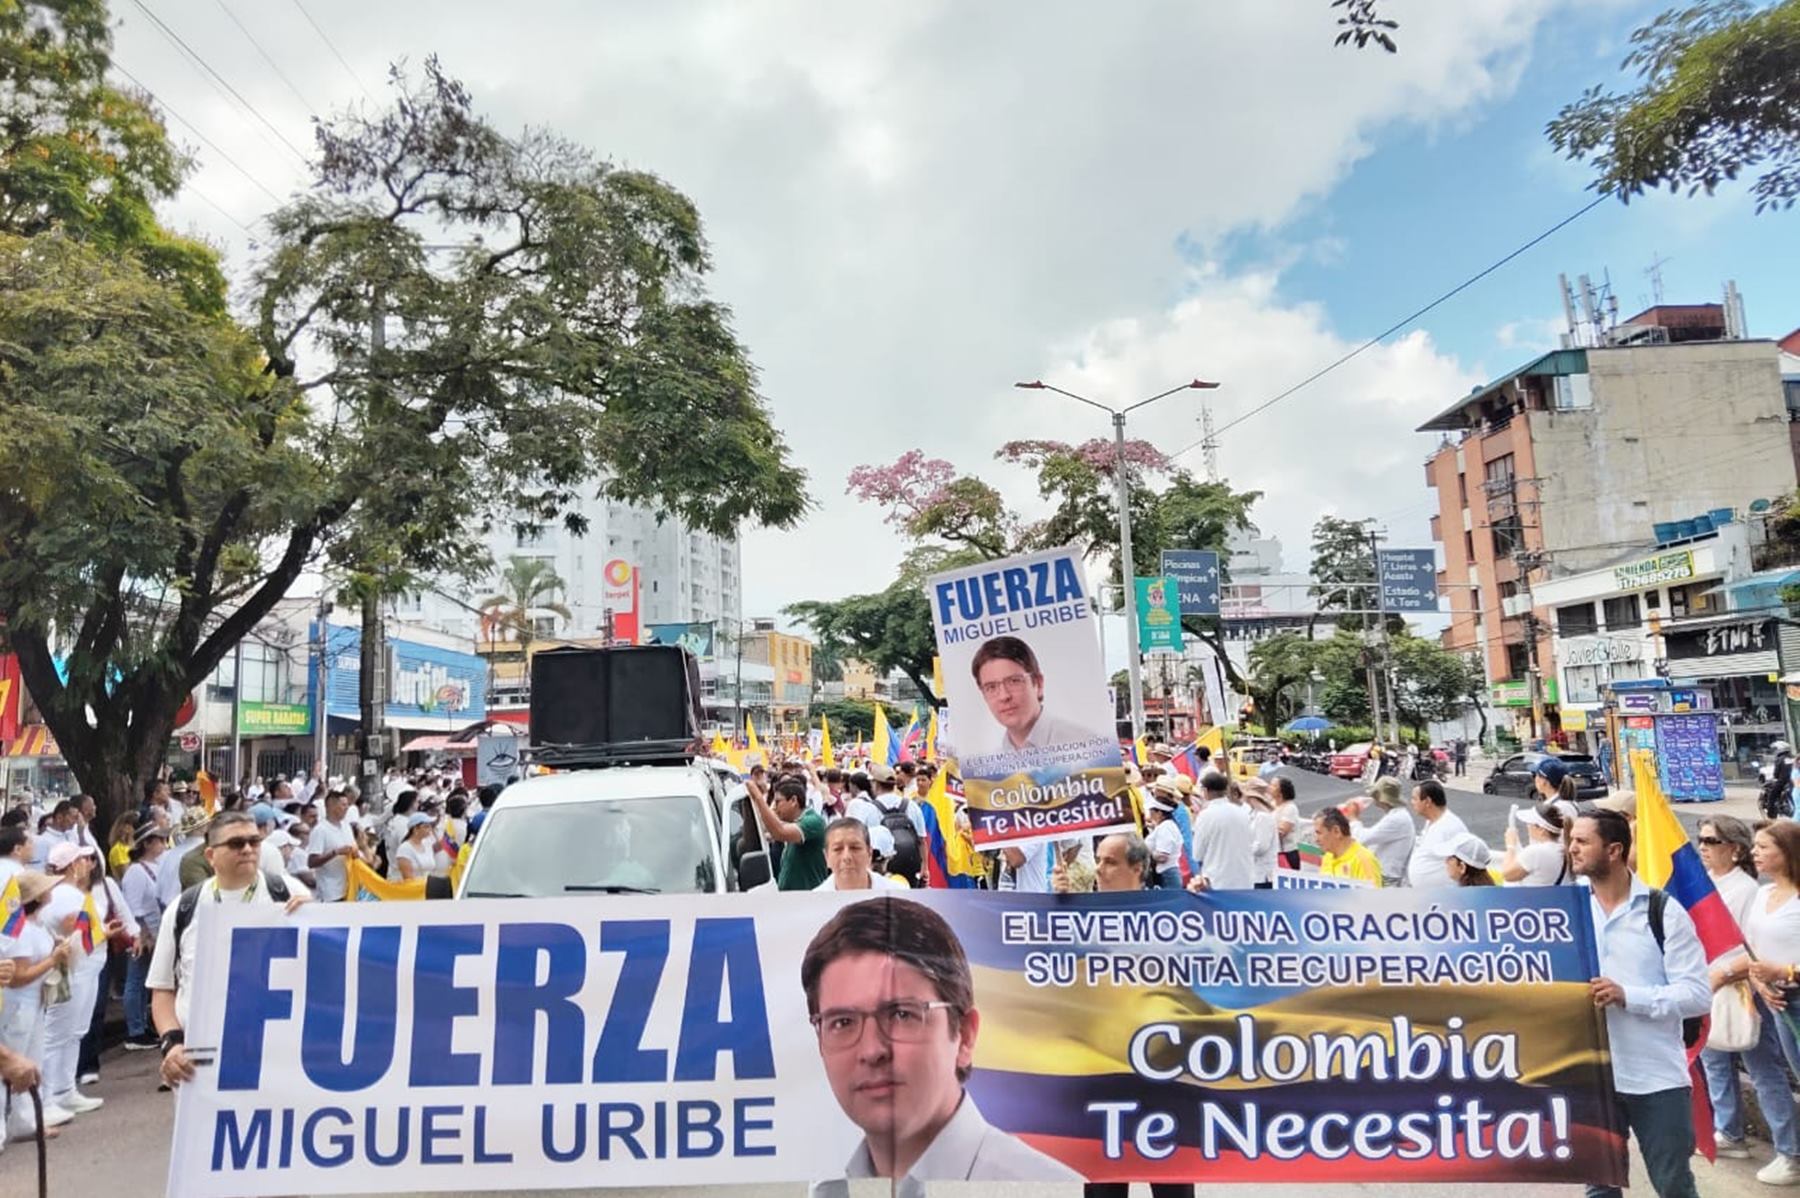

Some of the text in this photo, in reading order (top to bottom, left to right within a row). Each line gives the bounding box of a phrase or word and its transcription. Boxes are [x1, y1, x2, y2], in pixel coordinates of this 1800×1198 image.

[1164, 559, 1200, 569] Piscinas
[936, 557, 1083, 626] FUERZA
[1385, 586, 1420, 596] Estadio
[944, 603, 1088, 645] MIGUEL URIBE
[1089, 736, 1110, 748] POR
[990, 774, 1105, 808] Colombia
[981, 796, 1124, 836] Te Necesita!
[1002, 905, 1573, 943] ELEVEMOS UNA ORACIÓN POR
[1026, 944, 1553, 985] SU PRONTA RECUPERACIÓN
[216, 917, 777, 1093] FUERZA
[1128, 1014, 1521, 1082] Colombia
[211, 1097, 777, 1172] MIGUEL URIBE
[1086, 1095, 1574, 1160] Te Necesita!
